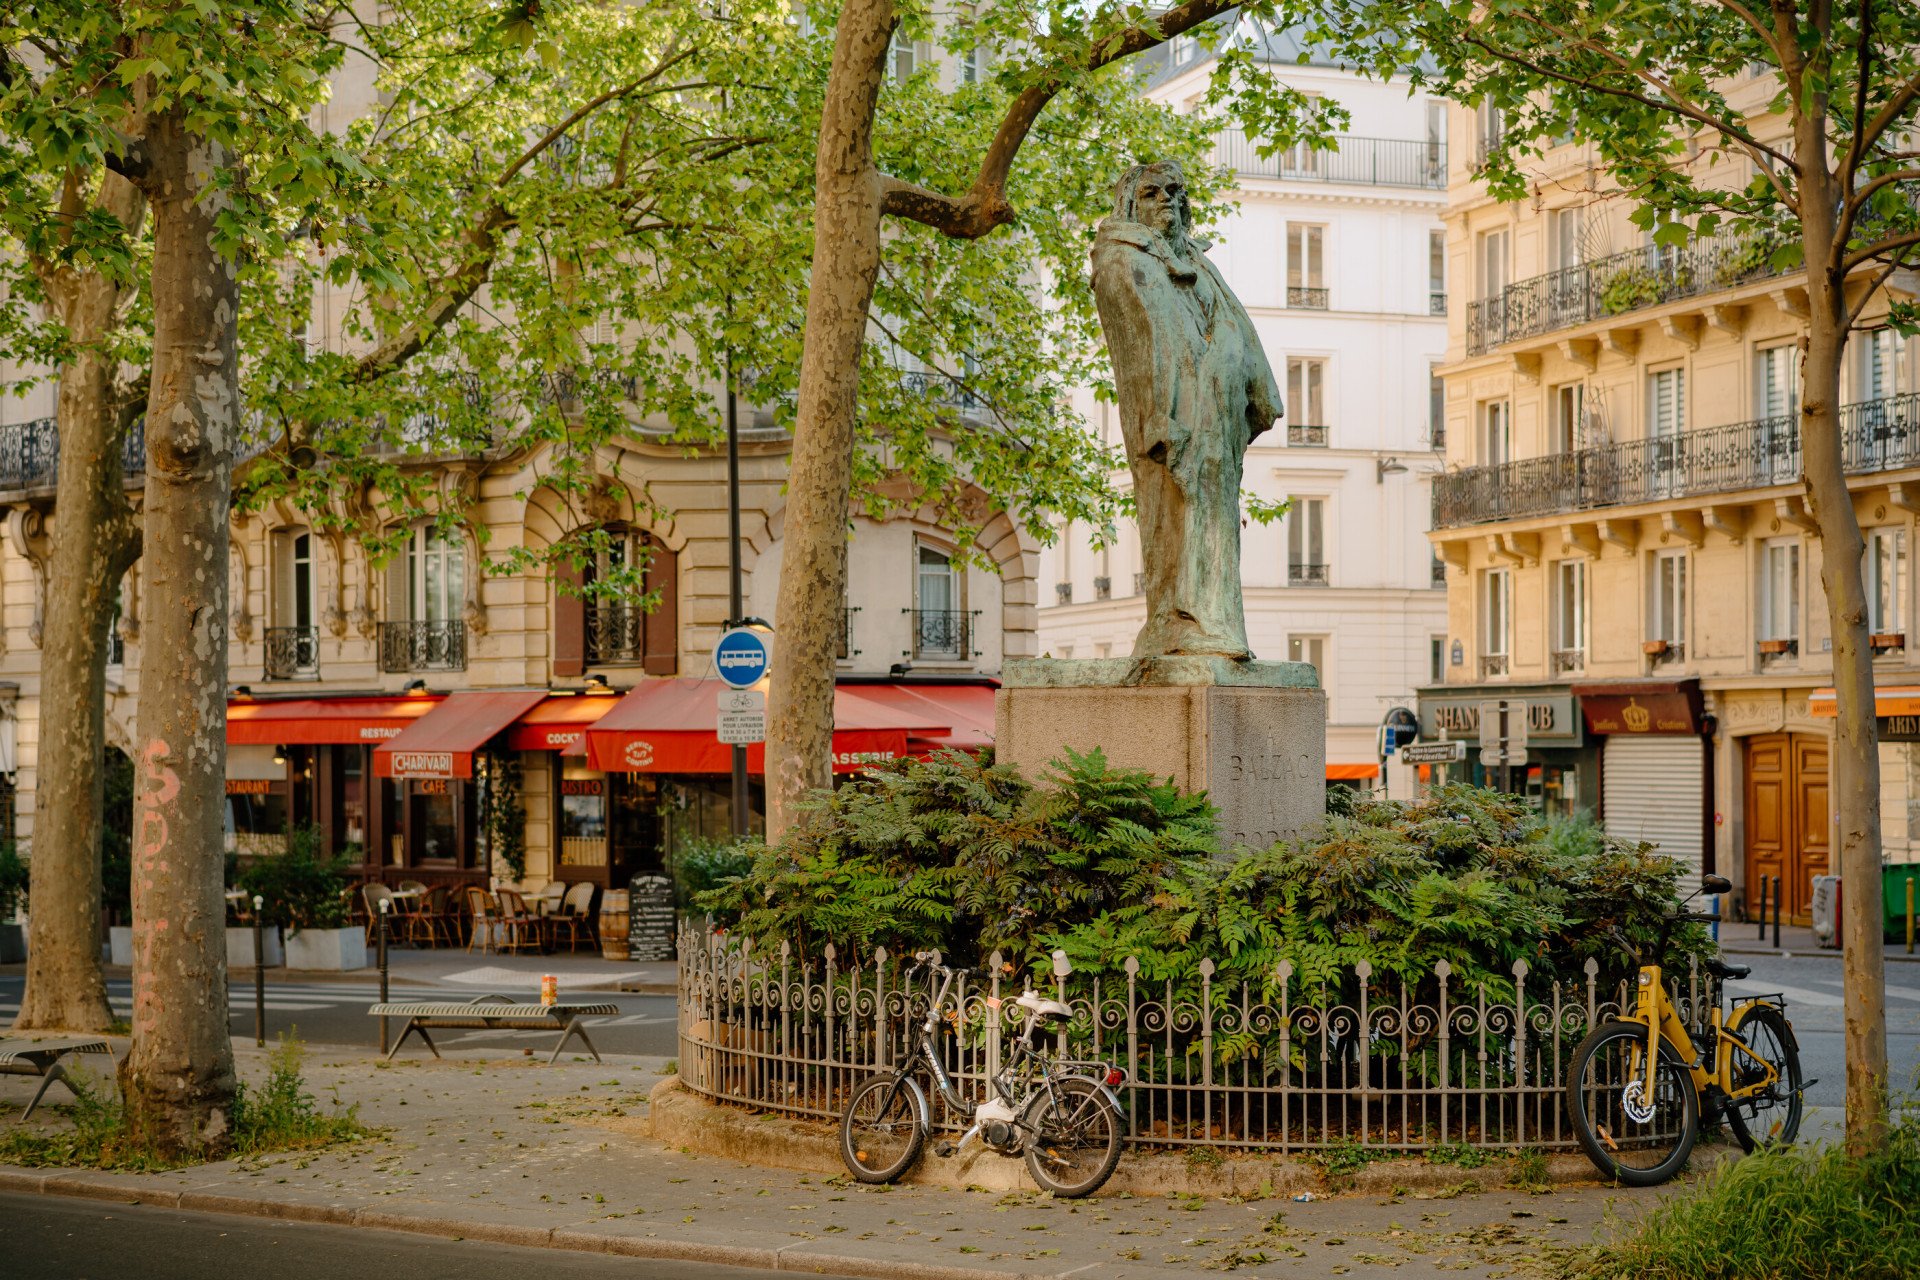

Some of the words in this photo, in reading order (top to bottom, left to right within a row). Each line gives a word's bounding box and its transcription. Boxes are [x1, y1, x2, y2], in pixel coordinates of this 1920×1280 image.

[1528, 703, 1554, 730] UB
[624, 741, 654, 753] SERVICE
[395, 754, 450, 771] CHARIVARI
[625, 756, 654, 767] CONTINU
[1231, 754, 1309, 780] BALZAC
[561, 781, 602, 795] BISTRO
